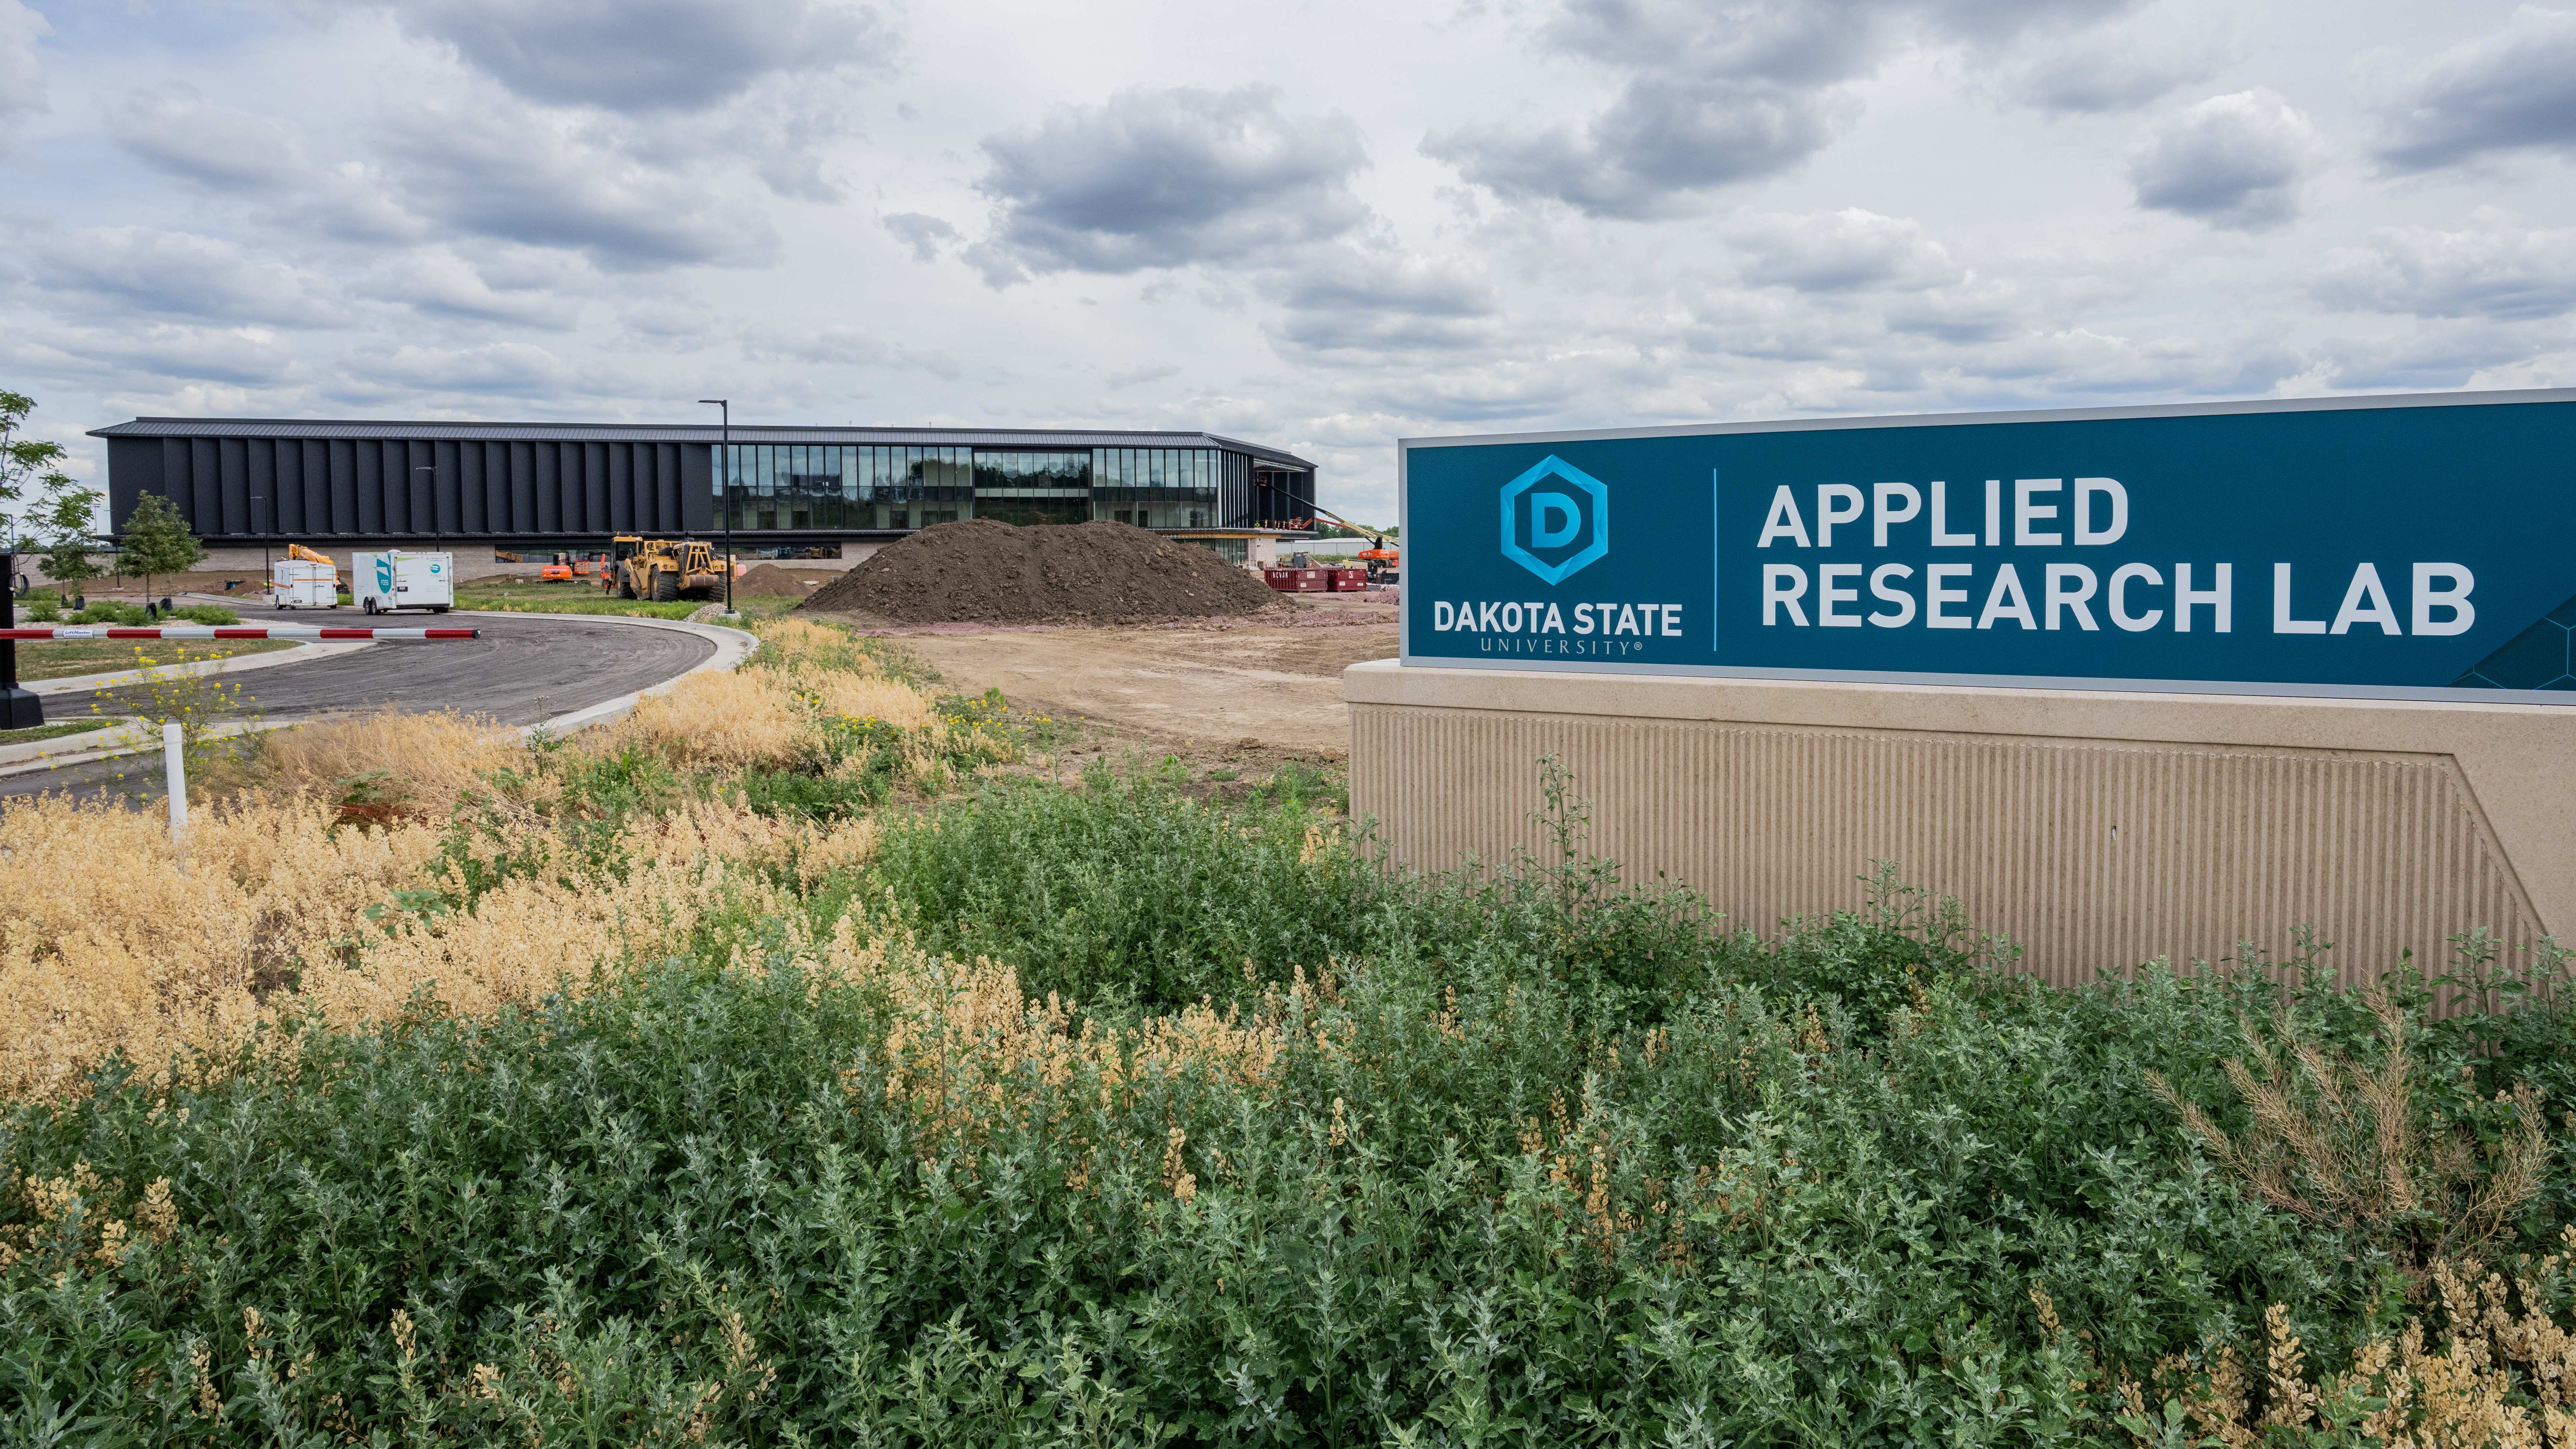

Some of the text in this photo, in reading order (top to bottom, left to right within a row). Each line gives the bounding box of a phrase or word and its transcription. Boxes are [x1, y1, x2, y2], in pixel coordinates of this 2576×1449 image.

[1531, 492, 1581, 548] D
[1757, 477, 2128, 547] APPLIED
[1435, 601, 1682, 636] DAKOTA STATE
[1763, 563, 2475, 636] RESEARCH LAB
